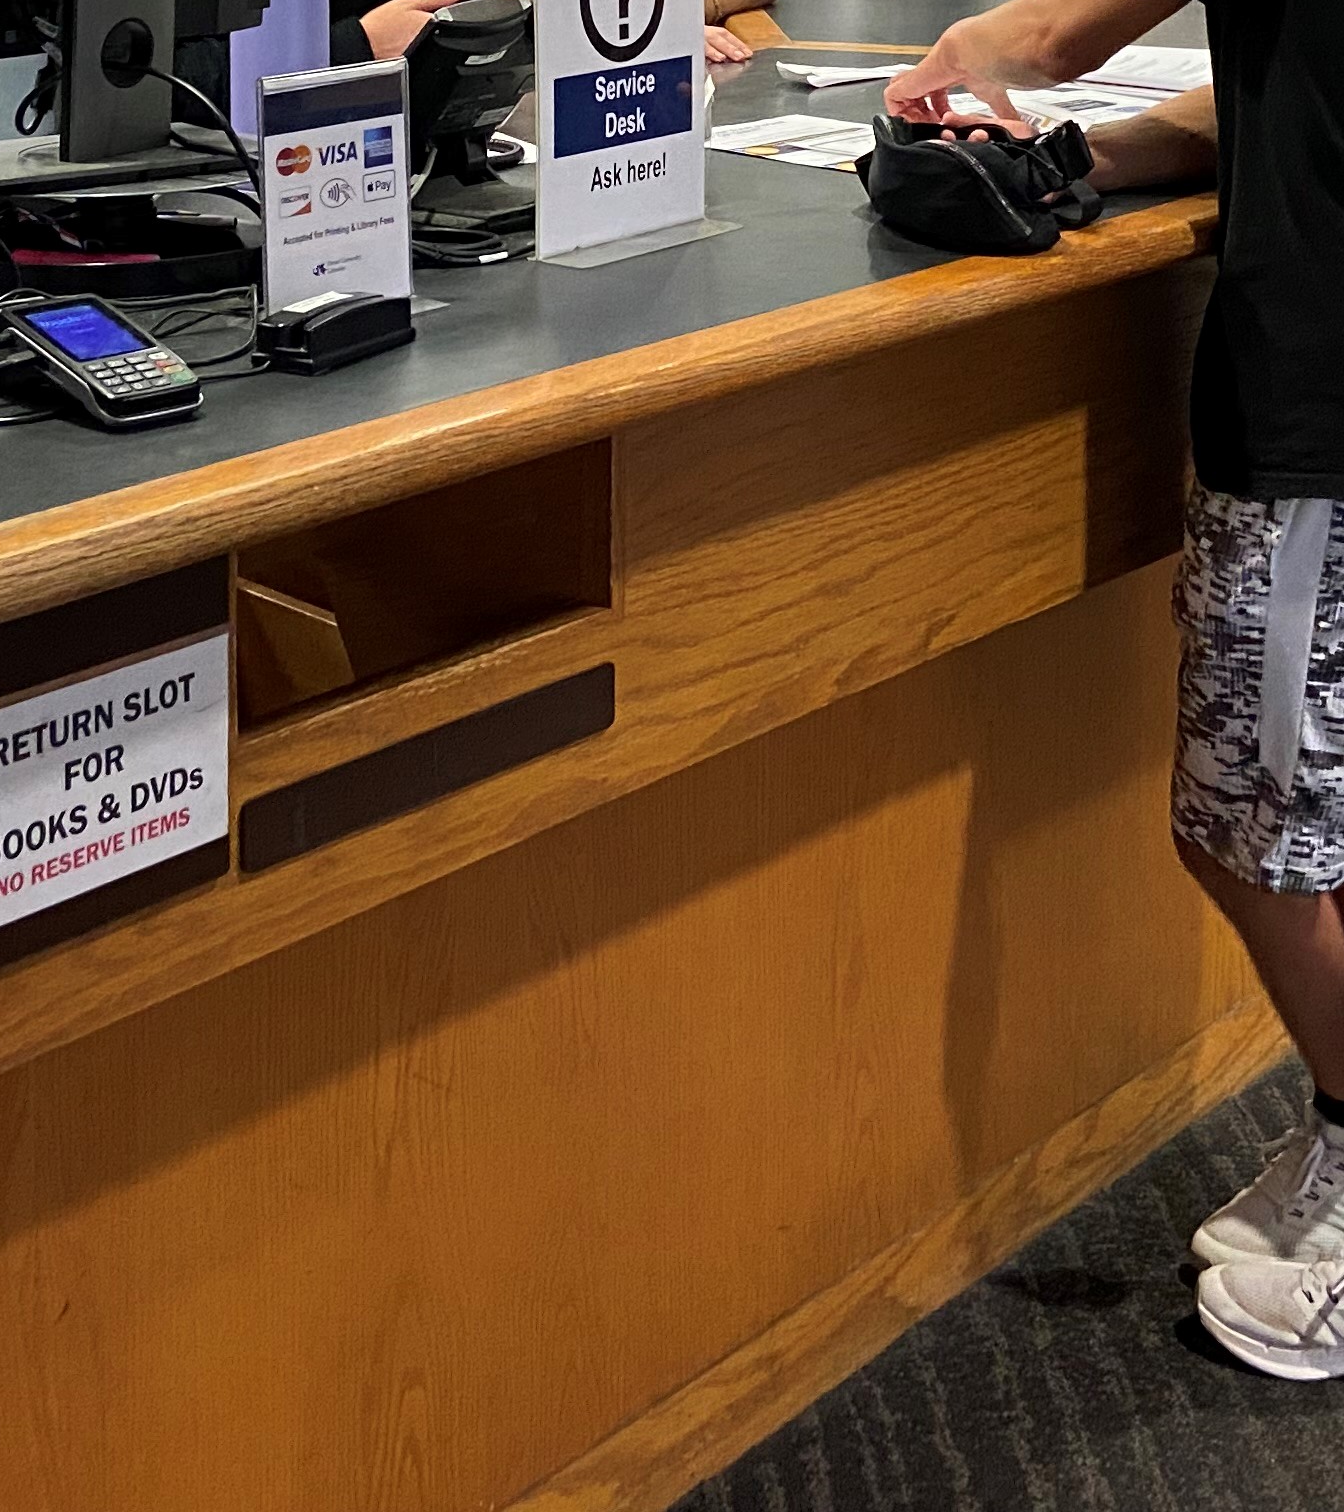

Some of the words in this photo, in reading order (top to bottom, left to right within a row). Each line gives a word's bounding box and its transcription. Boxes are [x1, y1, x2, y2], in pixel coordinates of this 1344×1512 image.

[595, 70, 656, 102] Service
[605, 106, 646, 138] Desk
[317, 140, 358, 167] VISA
[590, 162, 622, 192] Ask
[627, 151, 667, 184] here!
[374, 179, 393, 192] Pay
[123, 672, 196, 723] SLOT
[63, 744, 125, 791] FOR
[97, 792, 122, 824] &
[130, 766, 205, 814] DVDs
[30, 831, 126, 886] RESERVE
[130, 806, 192, 847] ITEMS
